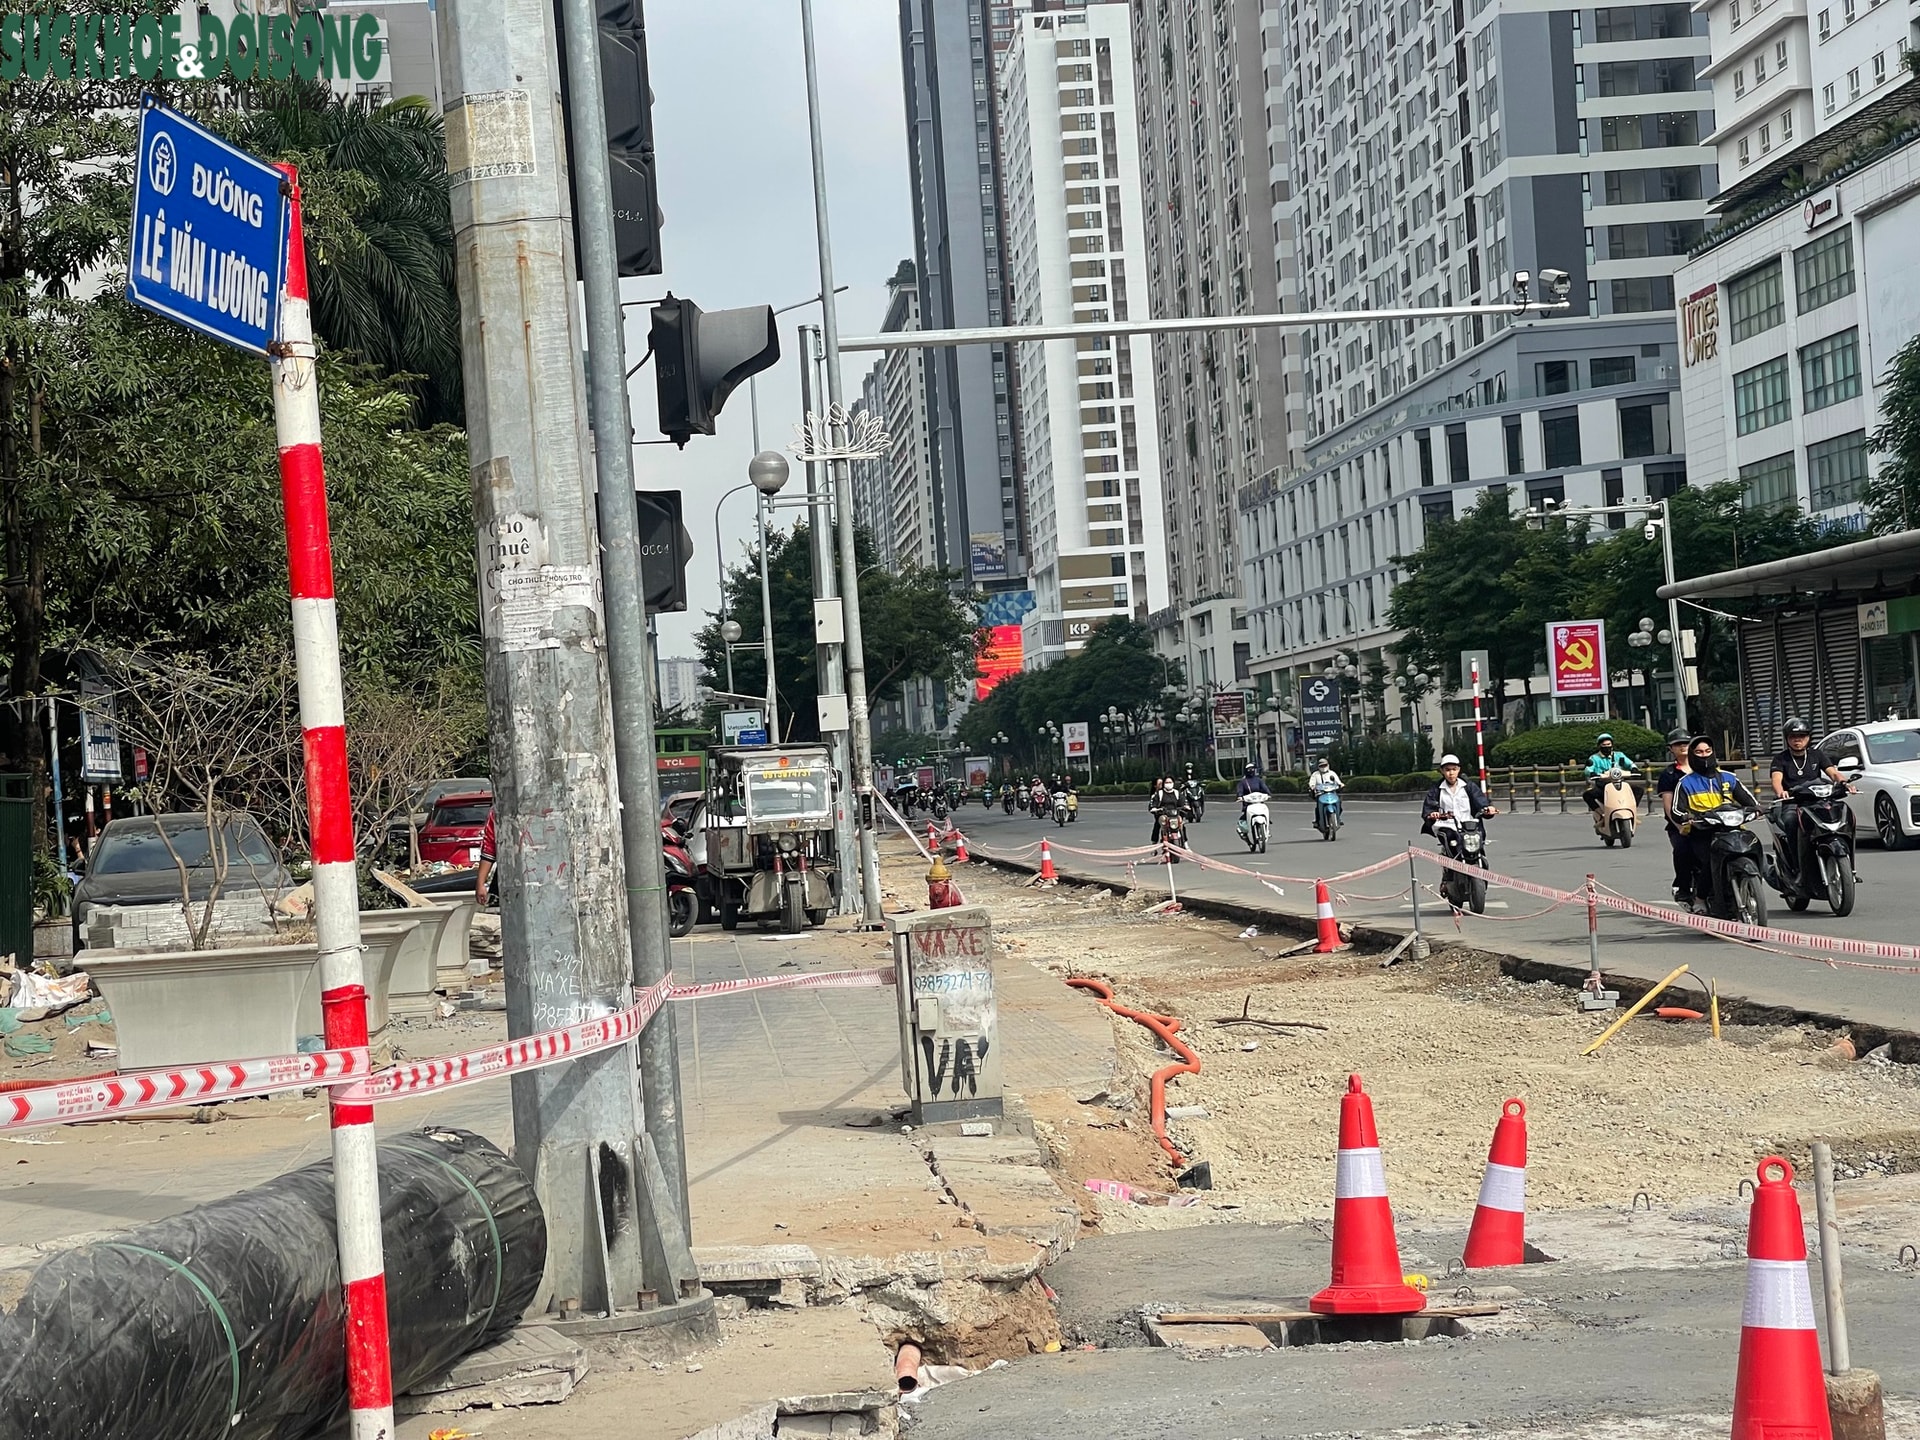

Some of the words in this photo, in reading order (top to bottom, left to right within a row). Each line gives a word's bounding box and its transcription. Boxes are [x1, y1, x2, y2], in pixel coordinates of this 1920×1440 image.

[191, 162, 263, 228] ĐƯỜNG
[140, 209, 166, 285] LÊ
[171, 221, 206, 303] VĂN
[207, 248, 269, 331] LƯƠNG
[488, 537, 531, 561] Thuê
[664, 758, 685, 767] TCL
